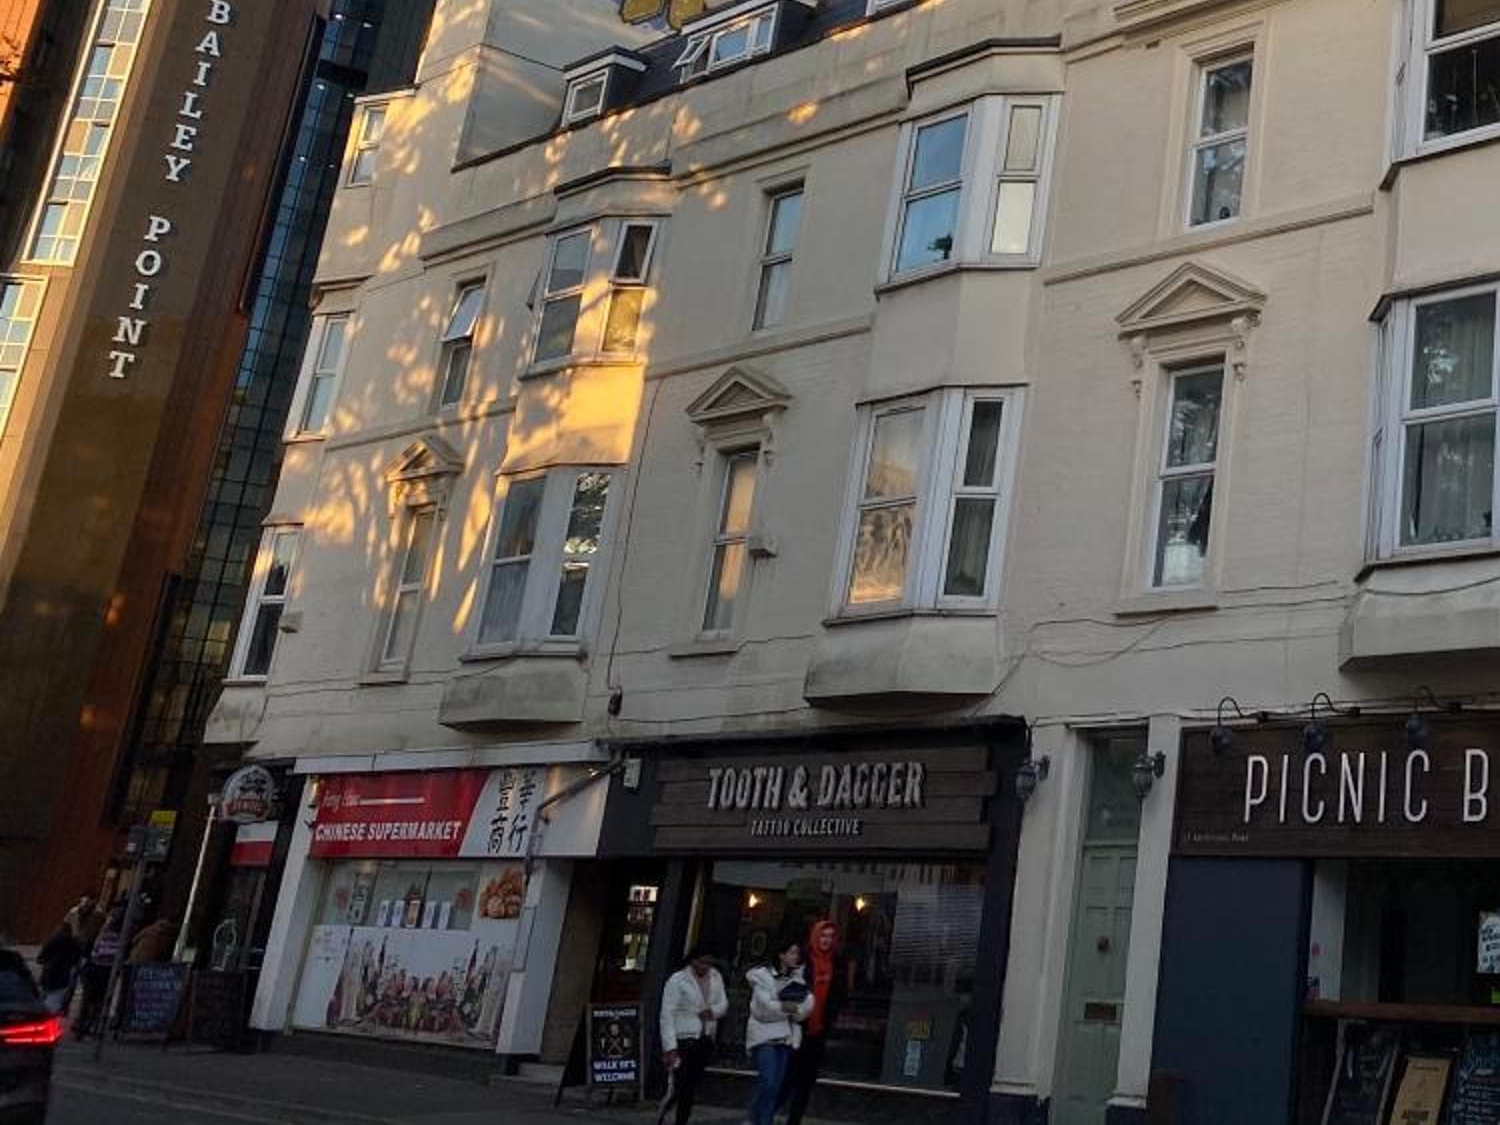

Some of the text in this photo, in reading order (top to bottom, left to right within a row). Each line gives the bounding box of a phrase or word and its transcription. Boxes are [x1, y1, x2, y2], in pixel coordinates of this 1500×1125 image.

[108, 216, 171, 380] POINT
[707, 762, 927, 809] TOOTH & DAGGER
[1243, 748, 1432, 824] PICNIC
[315, 820, 462, 841] CHINESE SUPERMARKET
[751, 818, 864, 836] TATTOO COLLECTIVE
